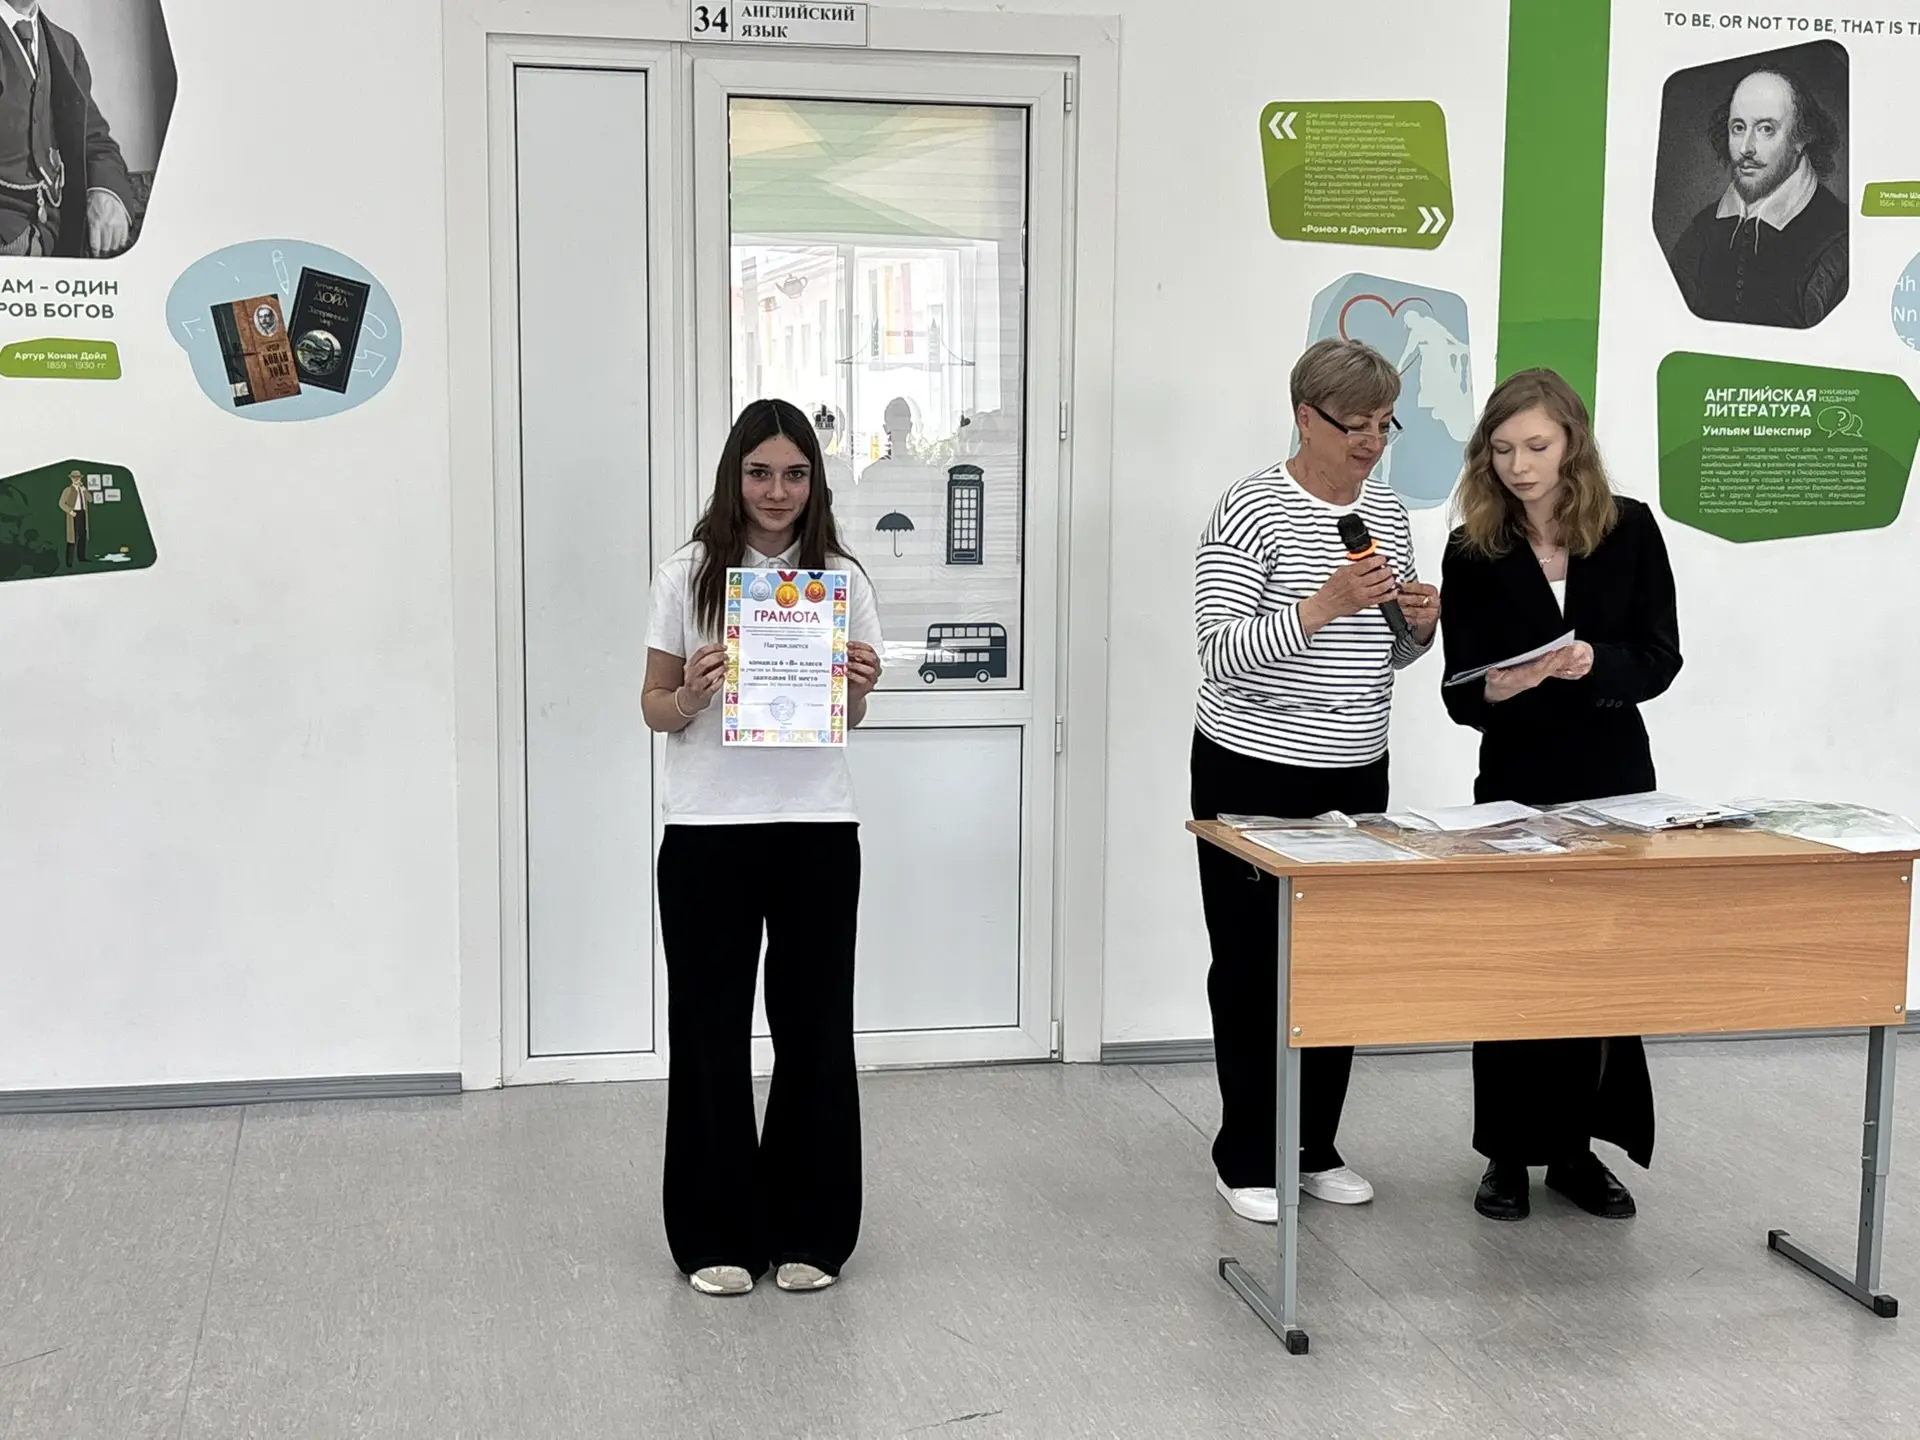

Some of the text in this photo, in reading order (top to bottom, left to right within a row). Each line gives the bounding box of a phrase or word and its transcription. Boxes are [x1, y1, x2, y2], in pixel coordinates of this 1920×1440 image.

[694, 6, 729, 33] 34
[741, 5, 855, 21] АНГЛИЙСКИЙ
[741, 25, 788, 38] ЯЗЫК
[1664, 12, 1687, 27] TO
[1691, 13, 1714, 29] BE,
[1719, 15, 1742, 28] OR
[1748, 16, 1782, 30] NOT
[1787, 17, 1809, 31] TO
[1814, 18, 1838, 34] BE,
[1841, 19, 1885, 34] THAT
[1889, 21, 1903, 35] IS
[1302, 225, 1338, 233] «Ромео
[1349, 225, 1408, 235] Джульетта»
[55, 280, 118, 298] ОДИН
[313, 289, 349, 309] ДОЙЛ
[43, 303, 114, 319] БОГОВ
[1894, 306, 1917, 322] Nn
[14, 351, 107, 361] Артур Конан Дойл
[46, 361, 67, 370] 1859
[75, 361, 95, 370] 1930
[1704, 385, 1817, 402] АНГЛИЙСКАЯ
[1704, 403, 1812, 418] ЛИТЕРАТУРА
[1702, 425, 1812, 438] Уильям Шекспир
[754, 610, 820, 623] ГРАМОТА
